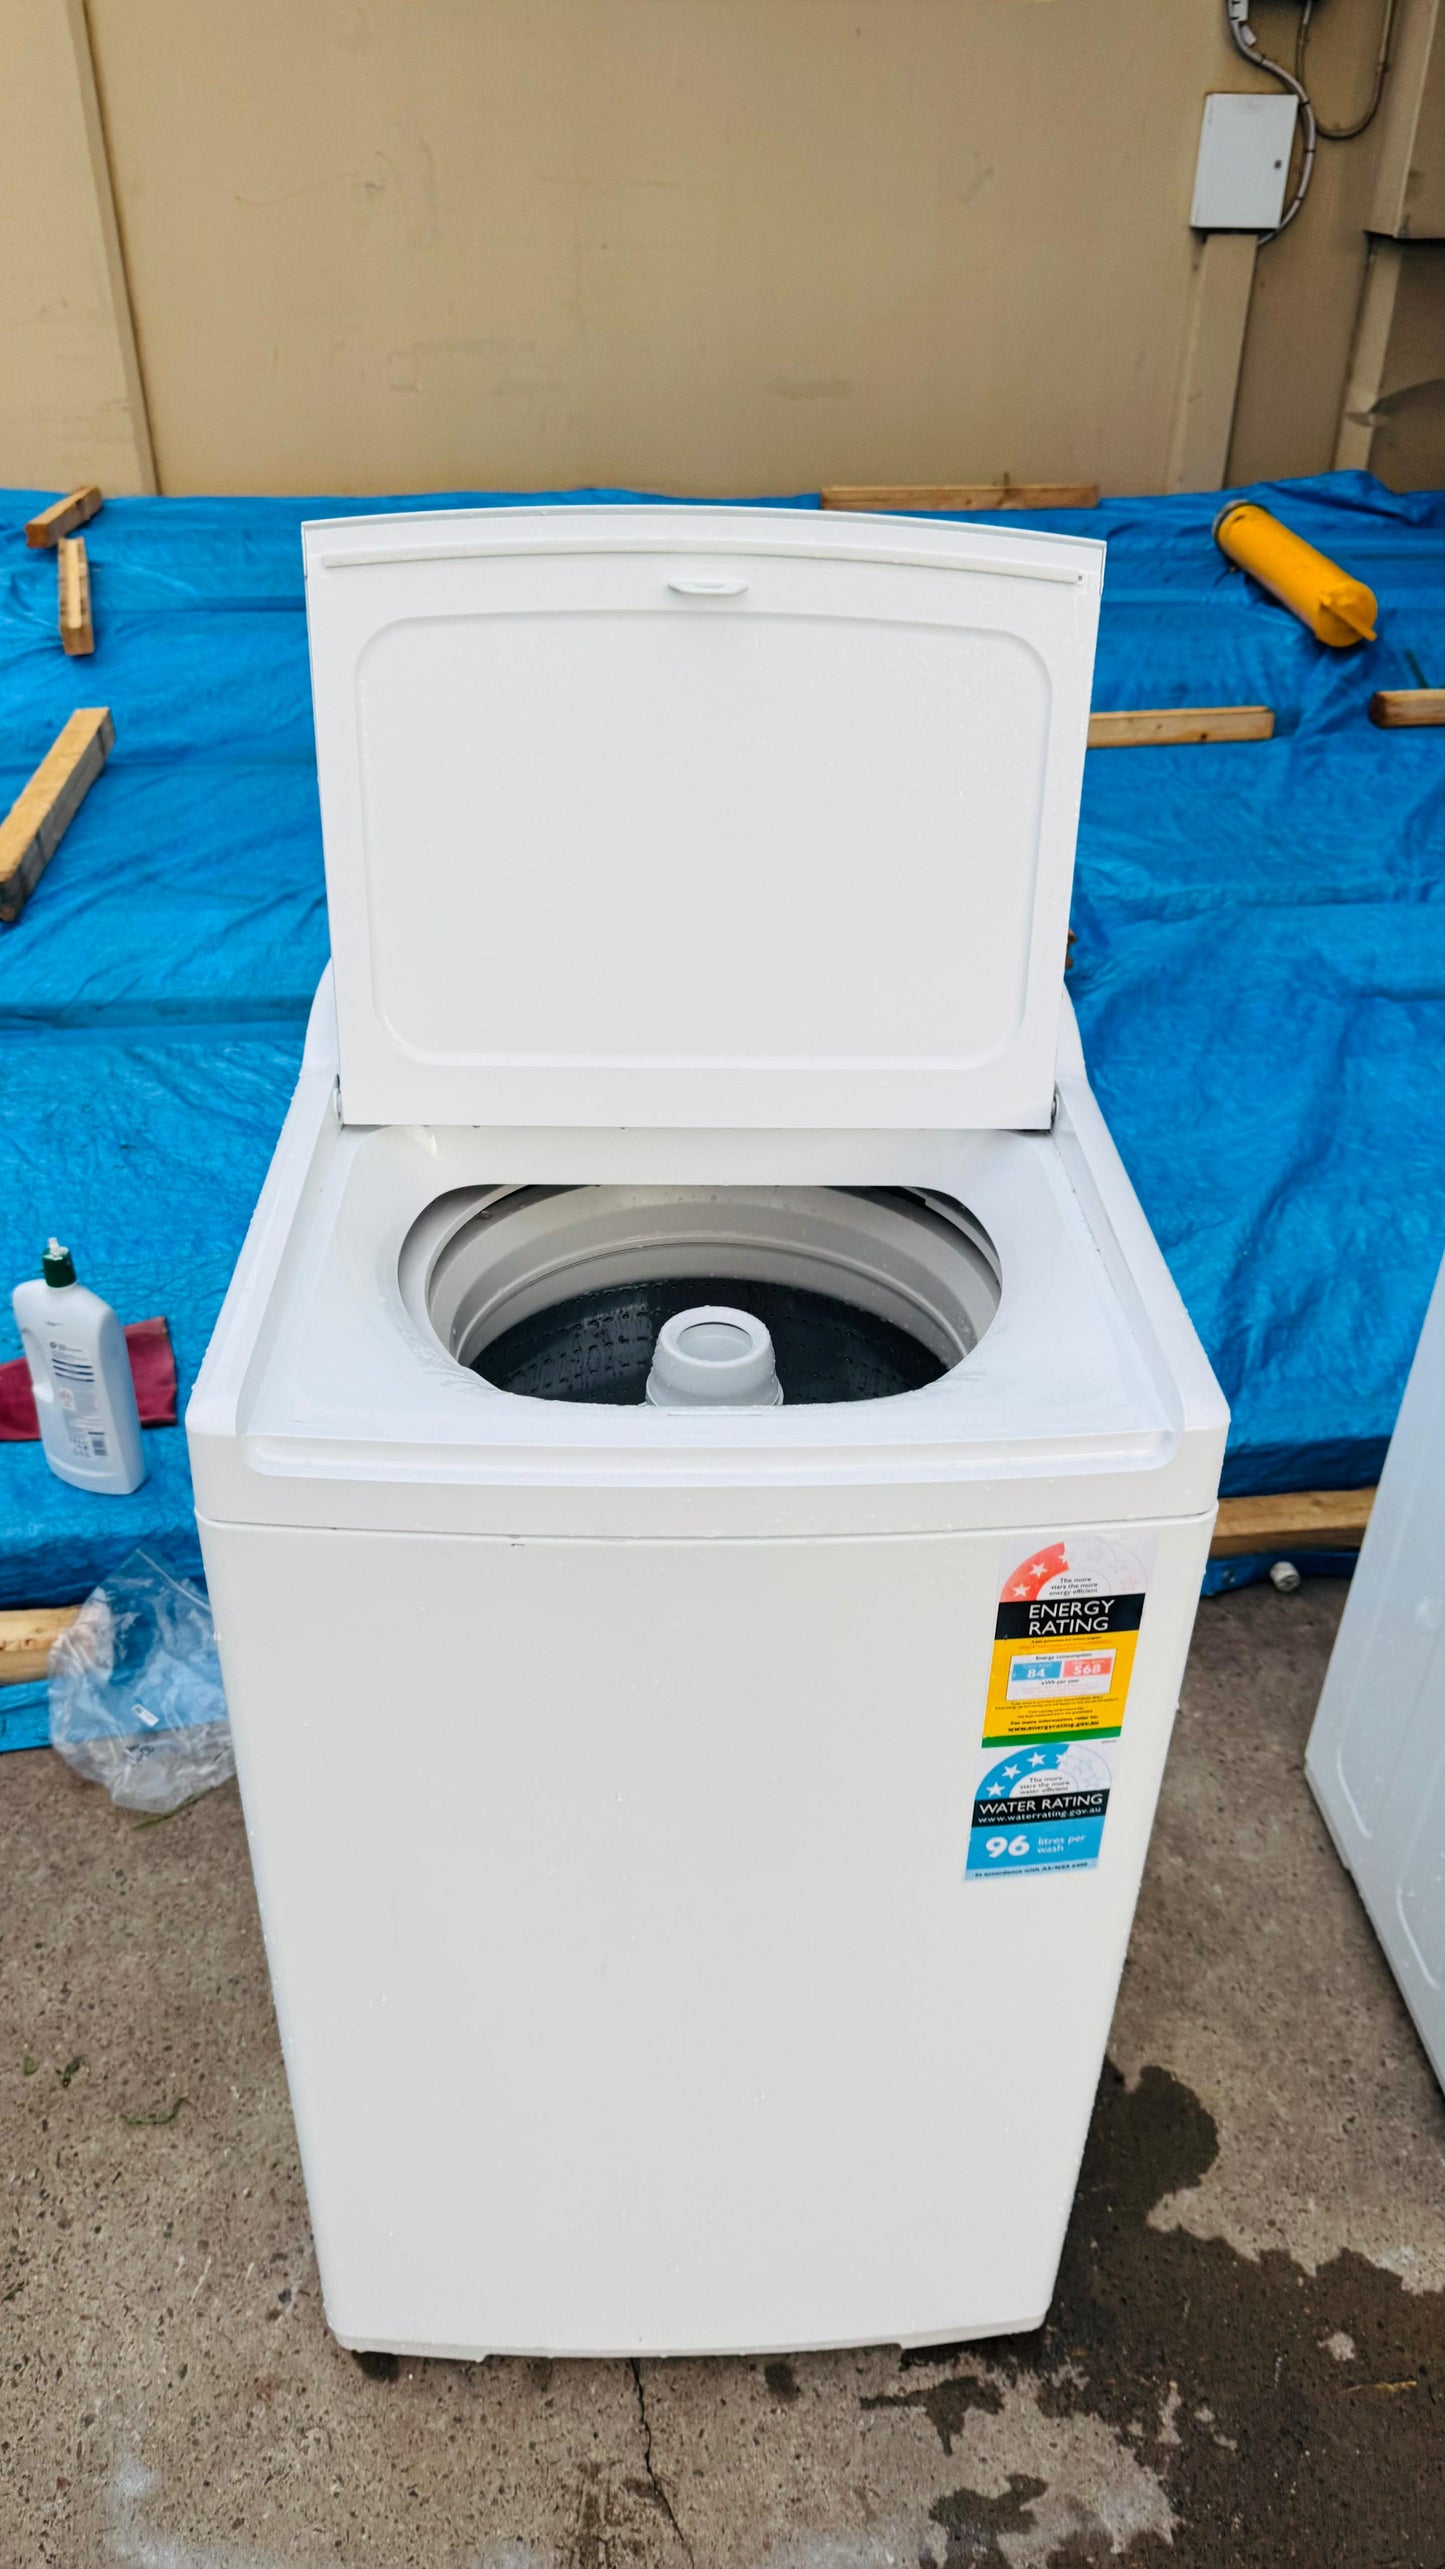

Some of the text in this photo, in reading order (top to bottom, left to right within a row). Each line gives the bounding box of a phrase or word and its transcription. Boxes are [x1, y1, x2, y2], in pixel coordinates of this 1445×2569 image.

[1029, 1599, 1115, 1619] ENERGY
[1029, 1617, 1109, 1635] RATING
[1027, 1667, 1045, 1679] 84
[1073, 1664, 1101, 1675] 568
[1008, 1721, 1099, 1732] www.energyrating.gov.au
[979, 1794, 1103, 1815] WATER RATING
[978, 1807, 1102, 1824] www.waterrating.gov.au
[985, 1834, 1031, 1858] 96
[1038, 1834, 1086, 1846] litres per
[1037, 1845, 1064, 1854] wash
[984, 1869, 1023, 1877] accordance
